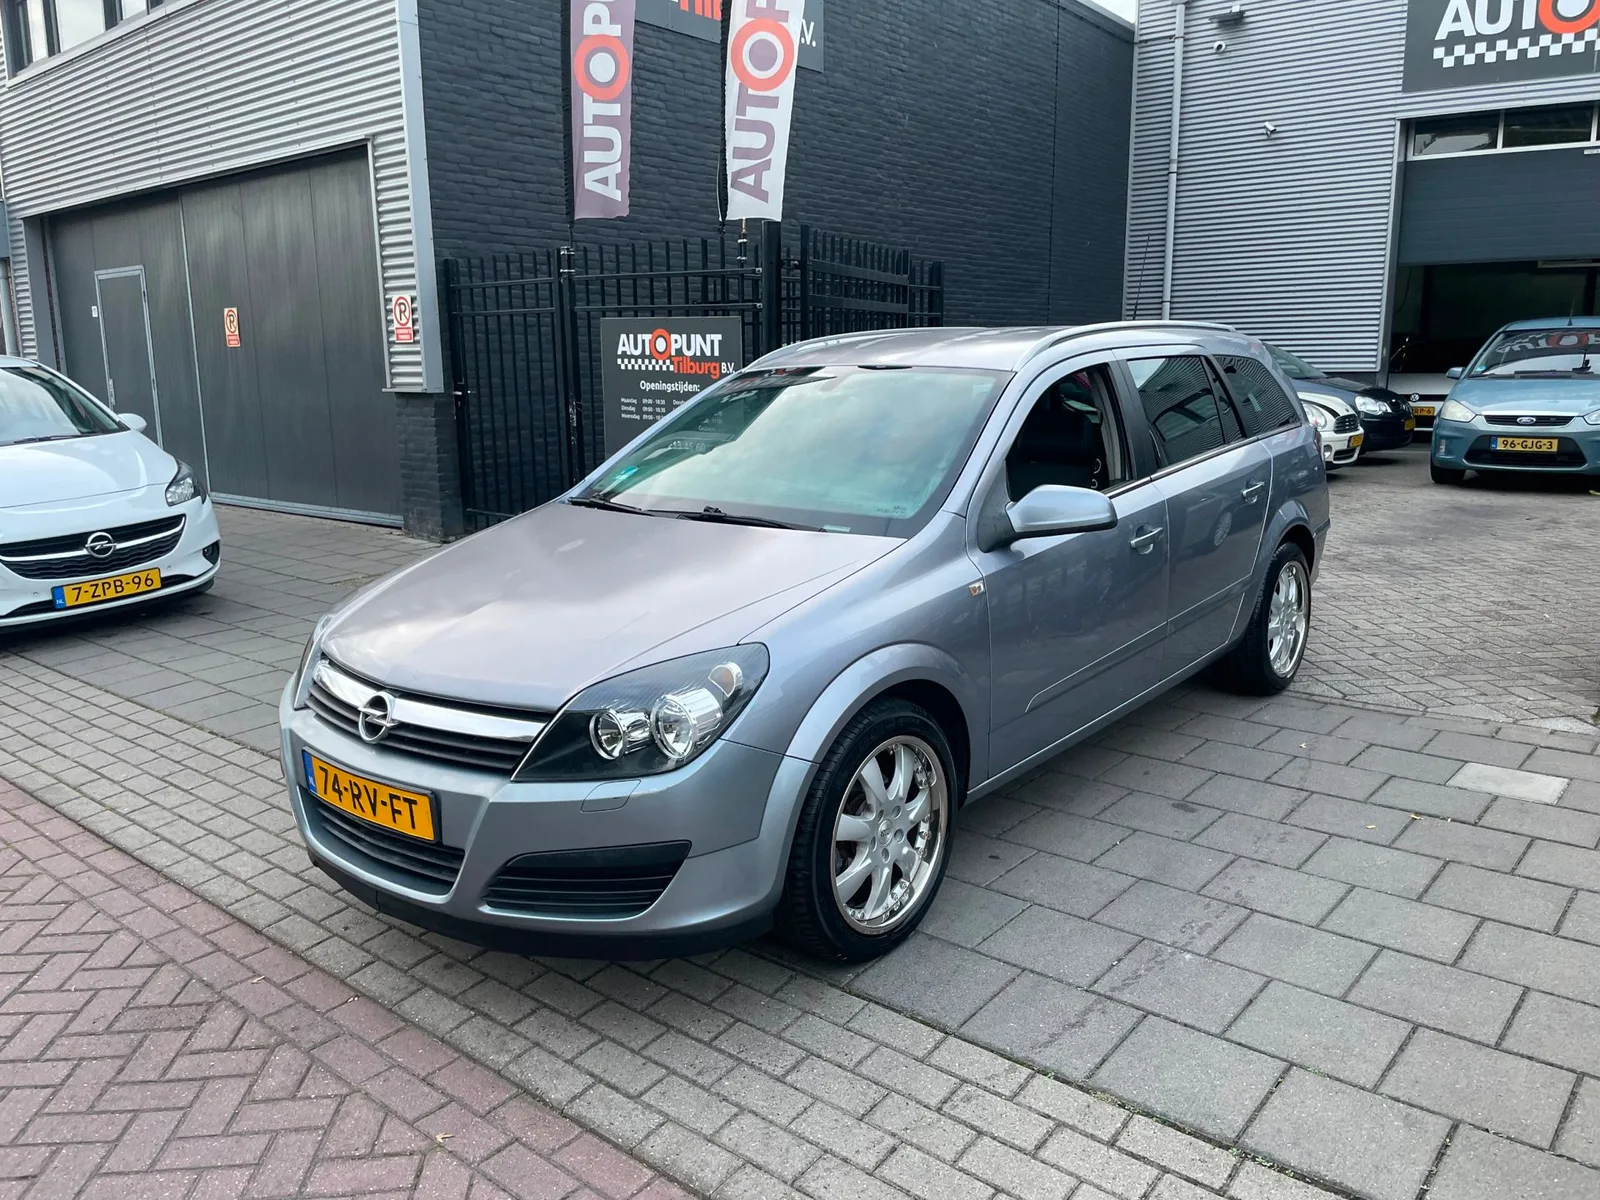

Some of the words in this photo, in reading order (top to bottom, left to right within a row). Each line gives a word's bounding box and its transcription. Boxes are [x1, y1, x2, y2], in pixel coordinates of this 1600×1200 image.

[574, 0, 630, 202] AUTOP
[617, 328, 722, 360] AUTOPUNT
[671, 357, 720, 379] Tilburg
[721, 362, 735, 373] B.V.
[640, 380, 700, 393] Openingstijden:
[1502, 439, 1554, 450] 96-GJG-3
[71, 573, 155, 602] 7-ZPB-96
[318, 765, 418, 830] 74-RV-FT
